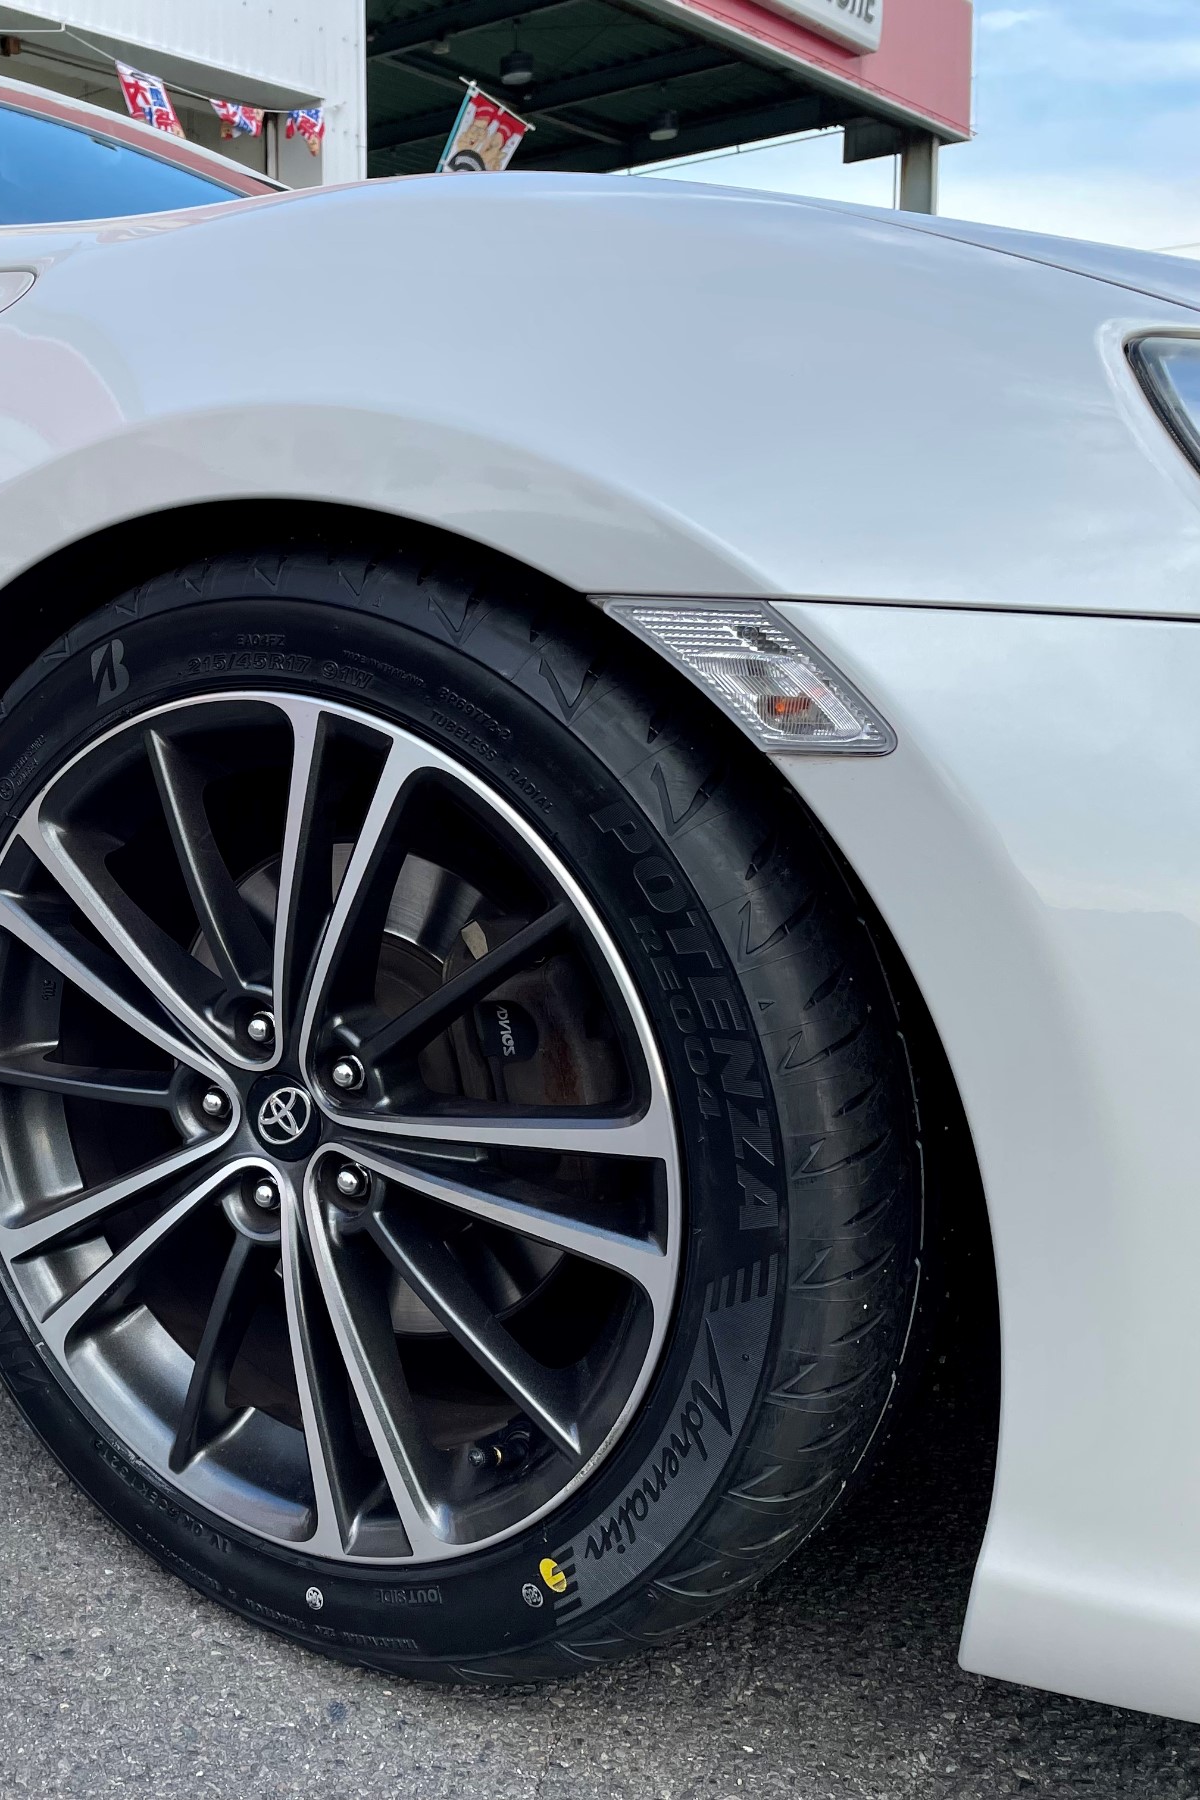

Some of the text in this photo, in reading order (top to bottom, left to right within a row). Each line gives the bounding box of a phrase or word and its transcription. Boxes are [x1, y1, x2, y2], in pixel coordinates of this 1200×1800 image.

[188, 651, 374, 689] 215/45R17 91W
[429, 709, 553, 815] TUBELESS RADIAL
[589, 800, 779, 1231] POTENZA
[629, 914, 723, 1121] RE004
[584, 1317, 733, 1560] Adrenalin
